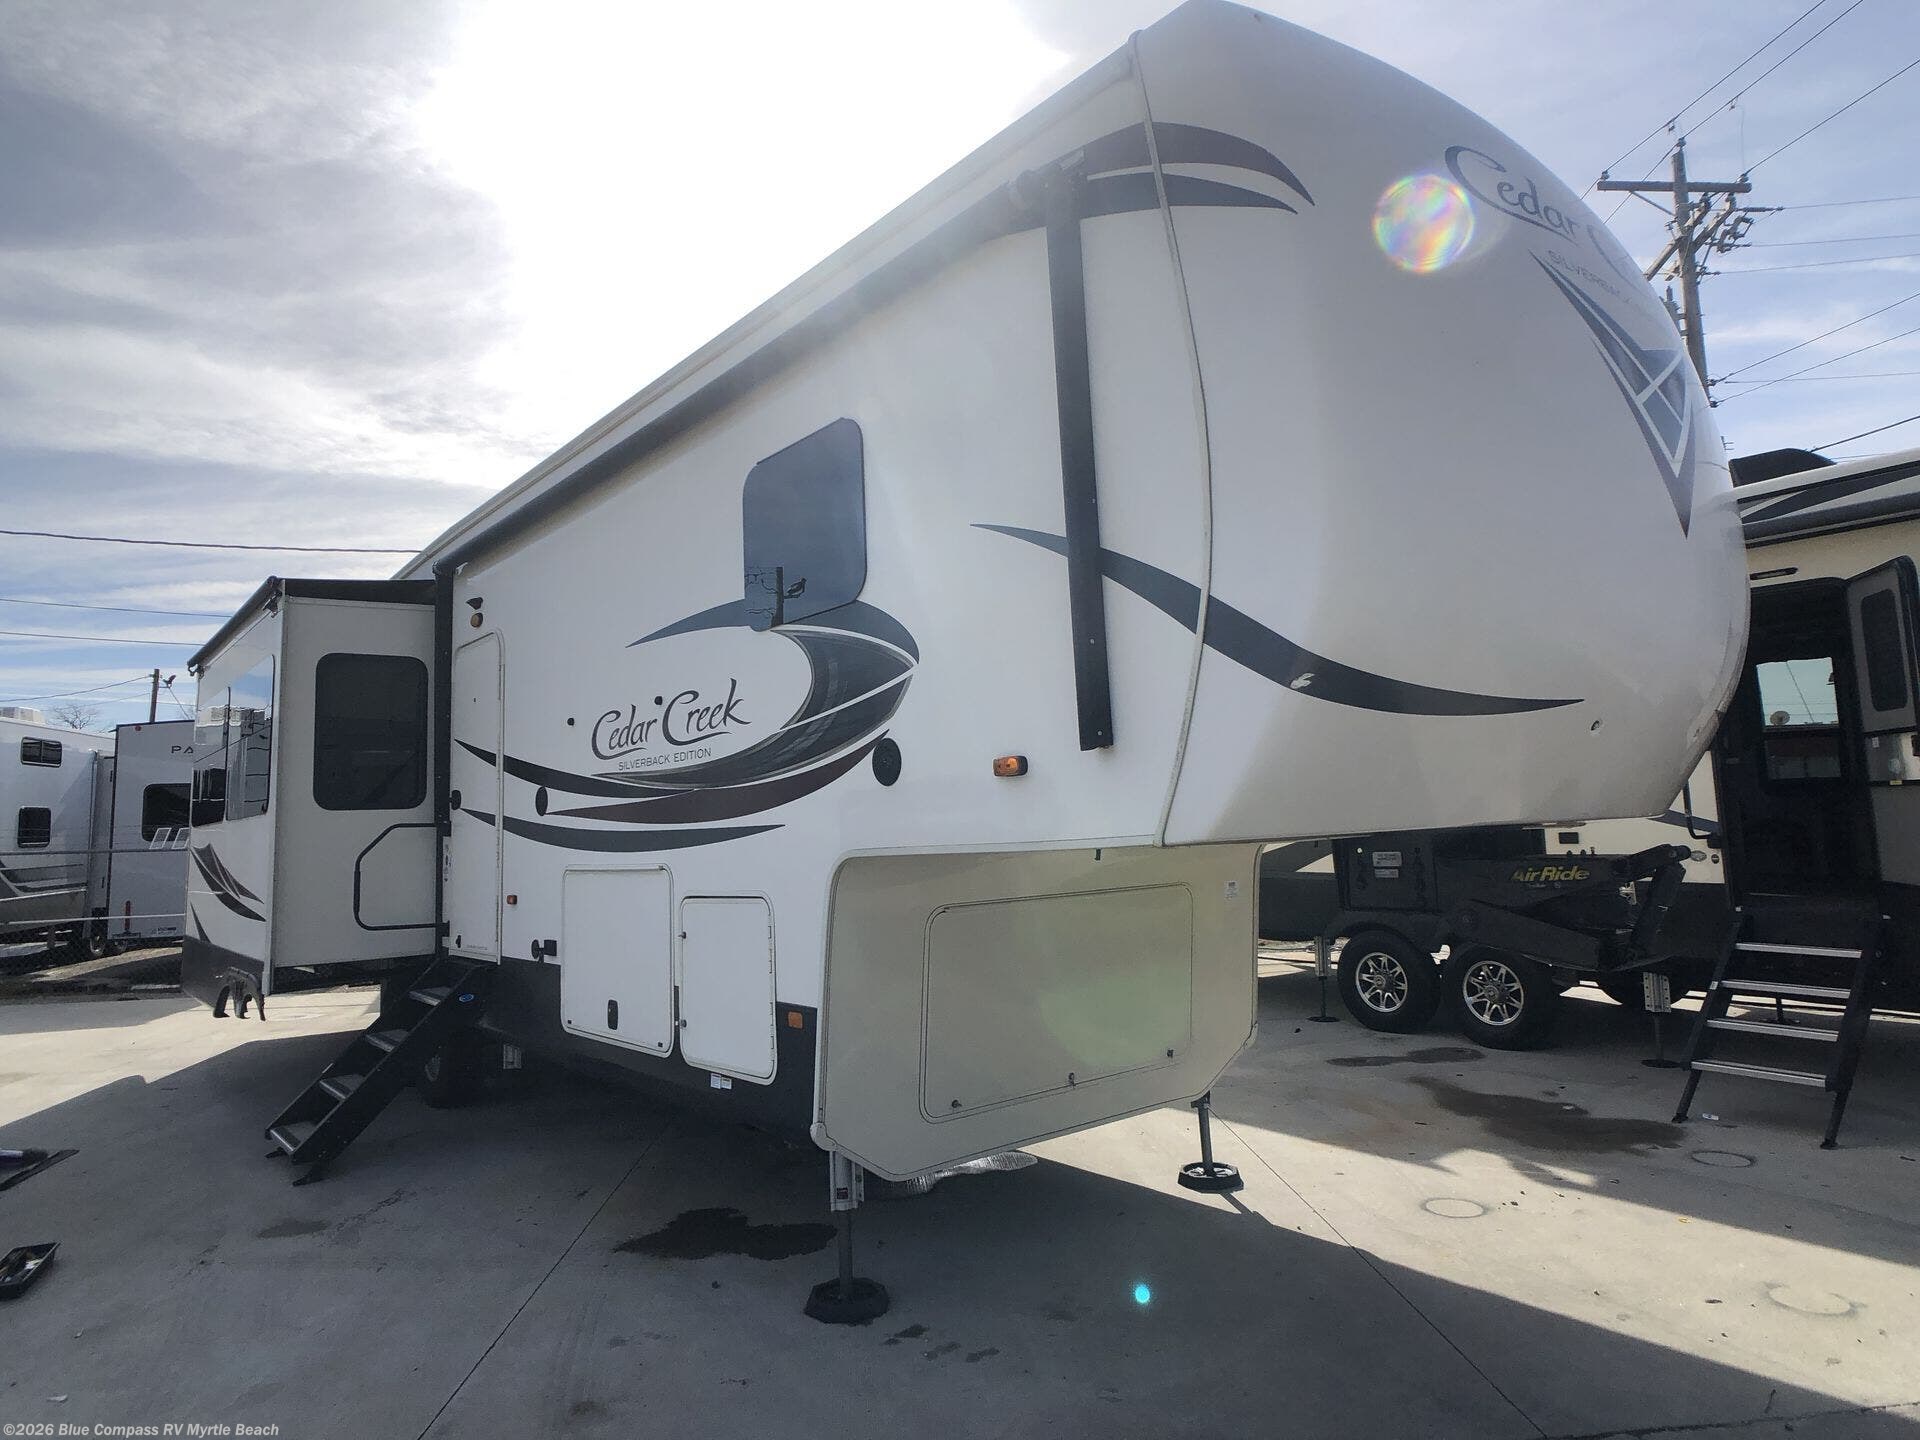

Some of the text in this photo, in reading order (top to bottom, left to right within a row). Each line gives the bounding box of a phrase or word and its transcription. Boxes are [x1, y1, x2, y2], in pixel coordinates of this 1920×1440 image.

[1445, 144, 1582, 246] Cedar
[591, 677, 751, 760] Cedar Creek
[618, 747, 712, 771] SILVERBACK EDITION
